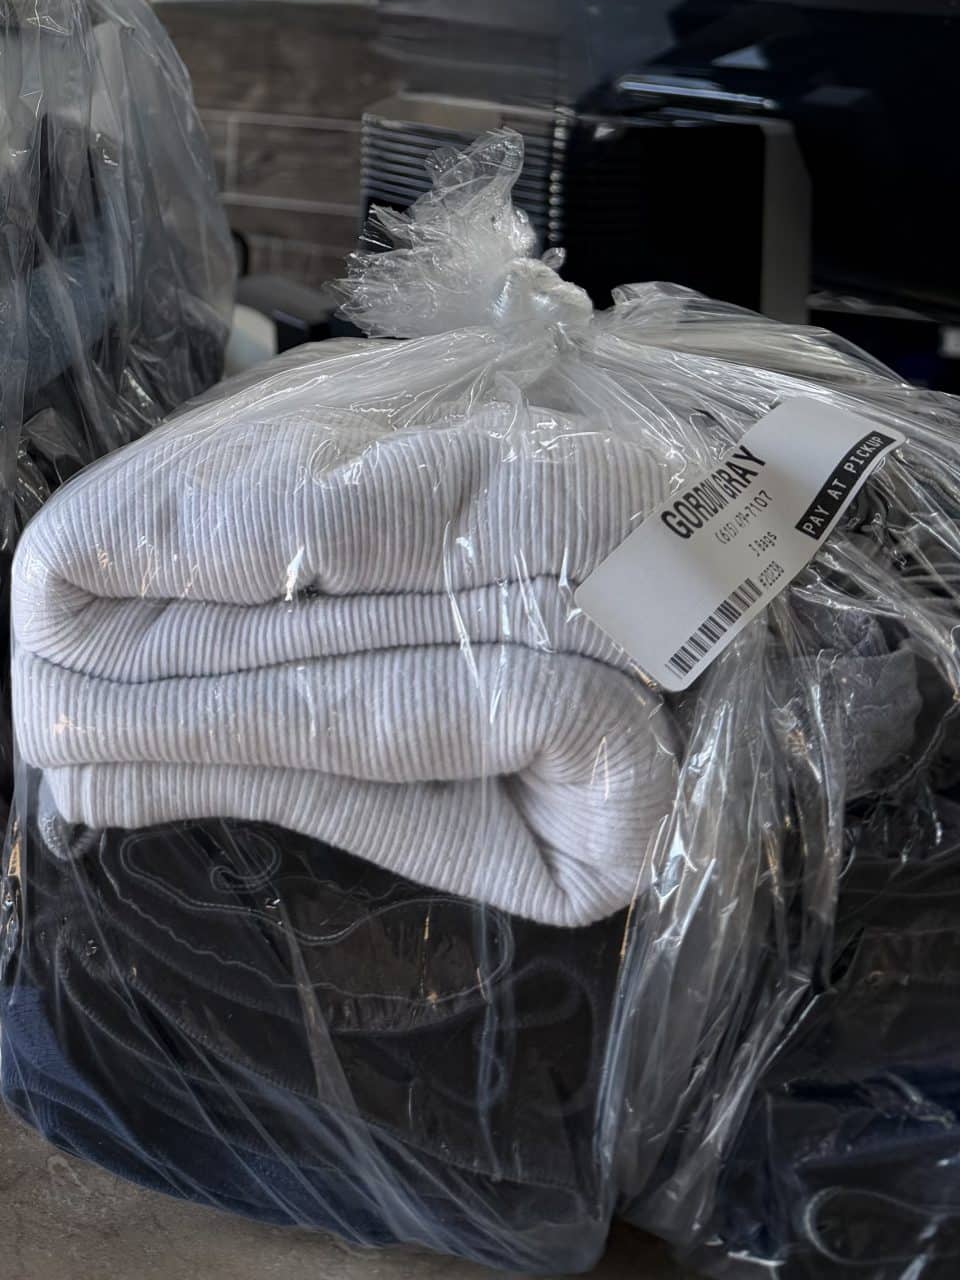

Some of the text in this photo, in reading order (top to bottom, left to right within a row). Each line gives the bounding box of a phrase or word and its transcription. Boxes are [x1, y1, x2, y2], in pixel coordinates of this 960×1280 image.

[710, 445, 767, 500] GRAY
[802, 436, 884, 535] PAY AT PICKUP
